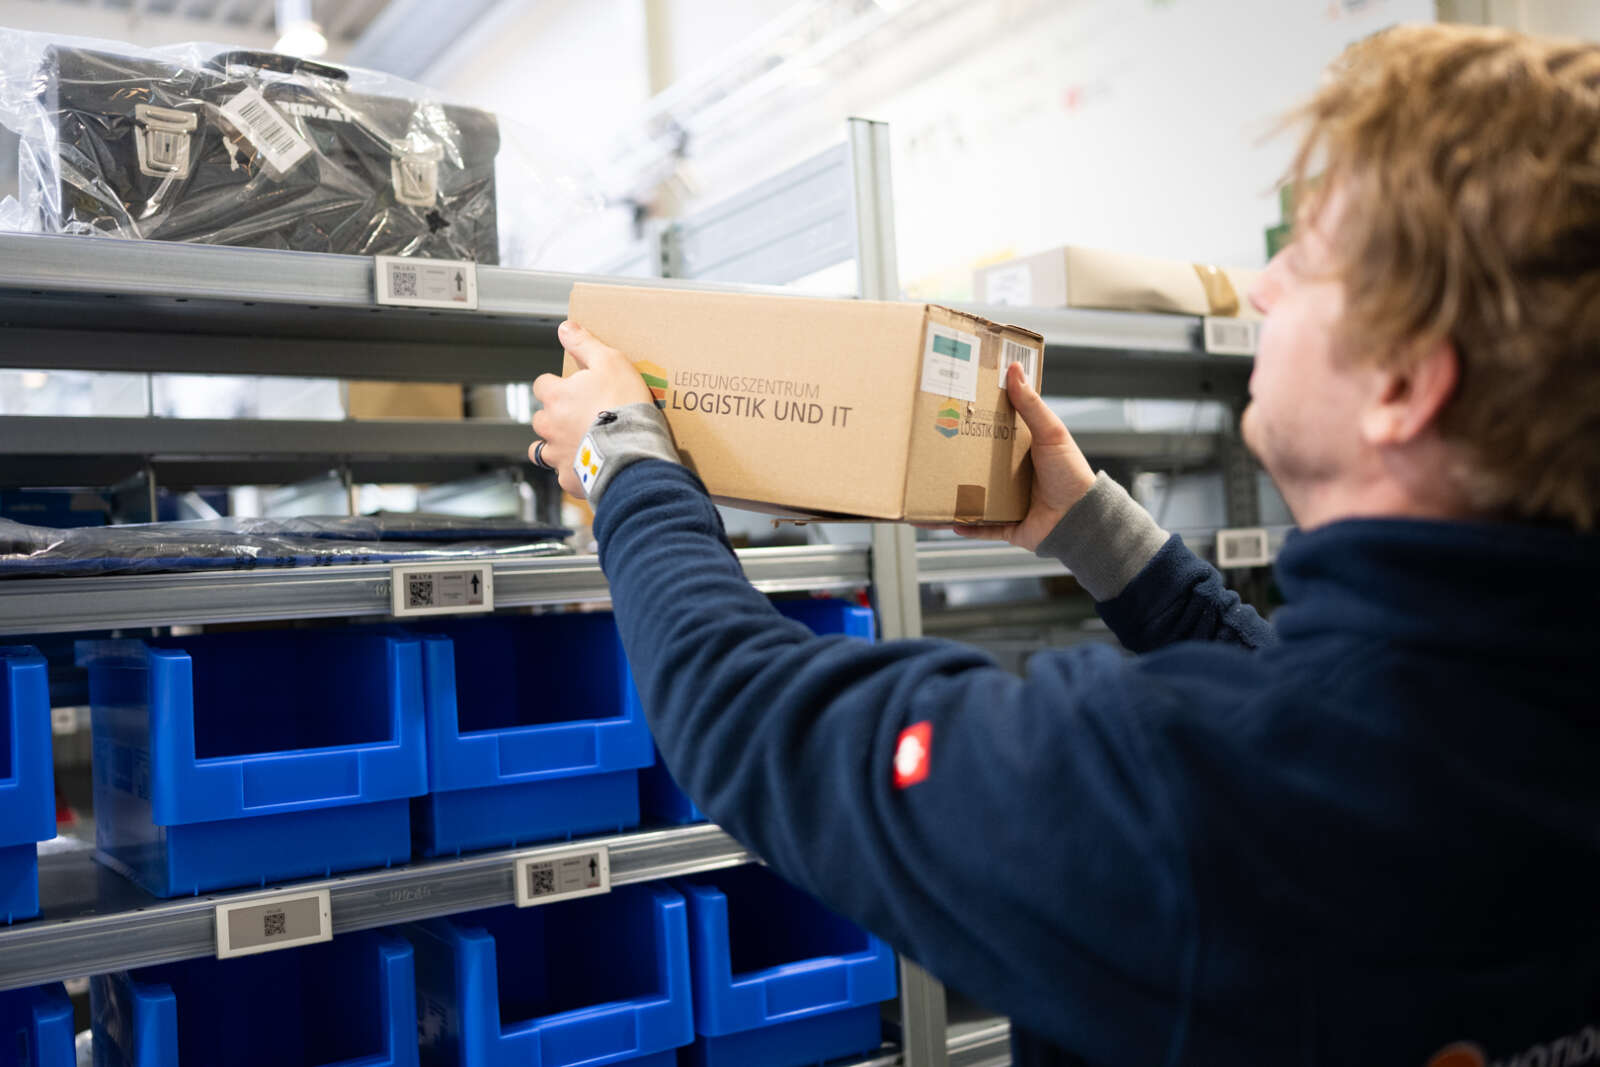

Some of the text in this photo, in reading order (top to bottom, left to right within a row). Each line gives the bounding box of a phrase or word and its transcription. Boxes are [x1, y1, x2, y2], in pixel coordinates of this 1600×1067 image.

[674, 371, 820, 399] LEISTUNGSZENTRUM
[672, 390, 853, 428] LOGISTIK UND IT
[961, 421, 992, 438] LOGISTIK
